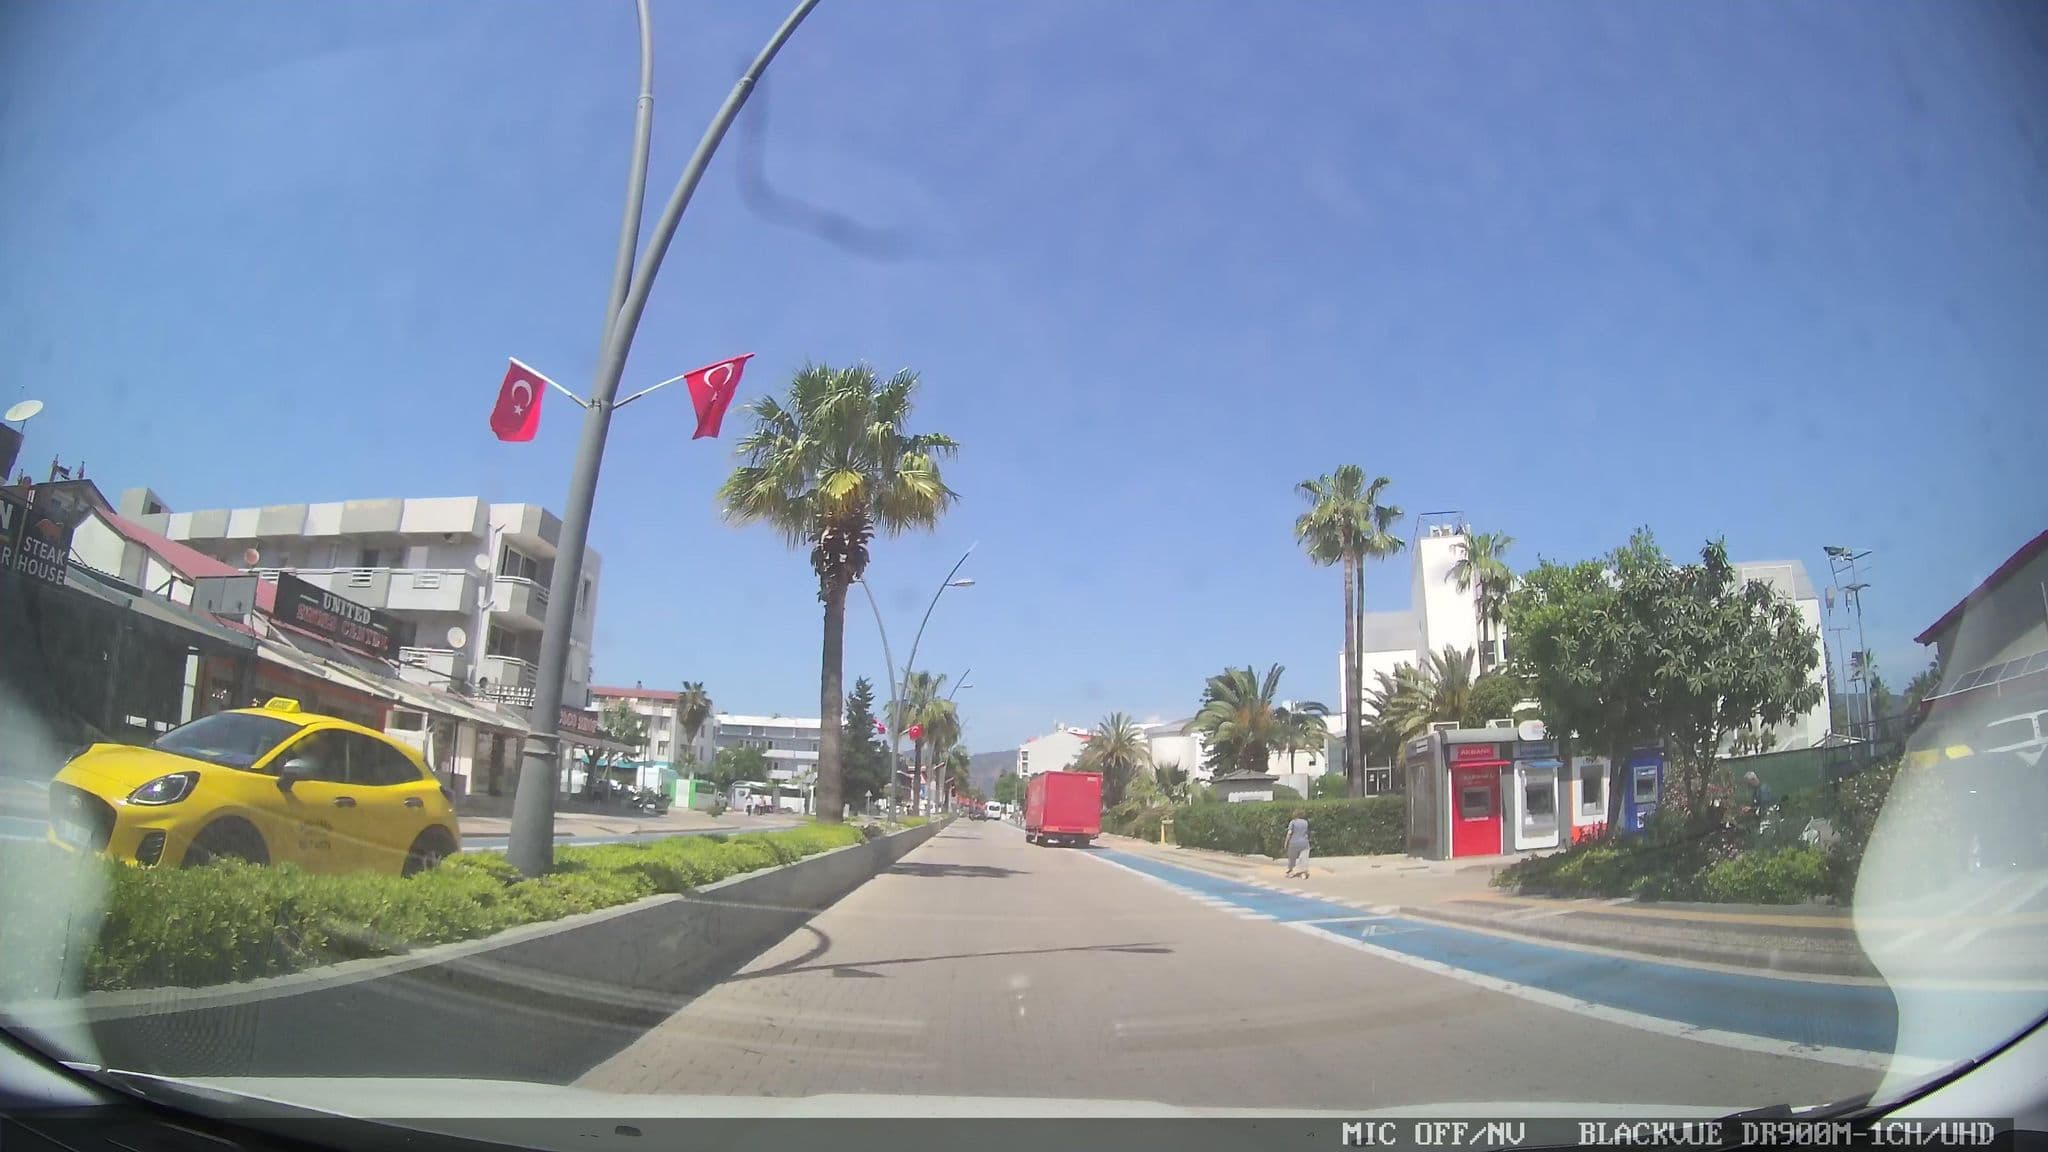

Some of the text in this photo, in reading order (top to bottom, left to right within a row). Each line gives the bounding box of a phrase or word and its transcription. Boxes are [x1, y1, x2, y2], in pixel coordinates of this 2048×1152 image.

[24, 536, 65, 567] STEAK
[18, 555, 64, 585] HOUSE
[323, 592, 371, 625] UNITED
[1460, 747, 1491, 756] AKBANK
